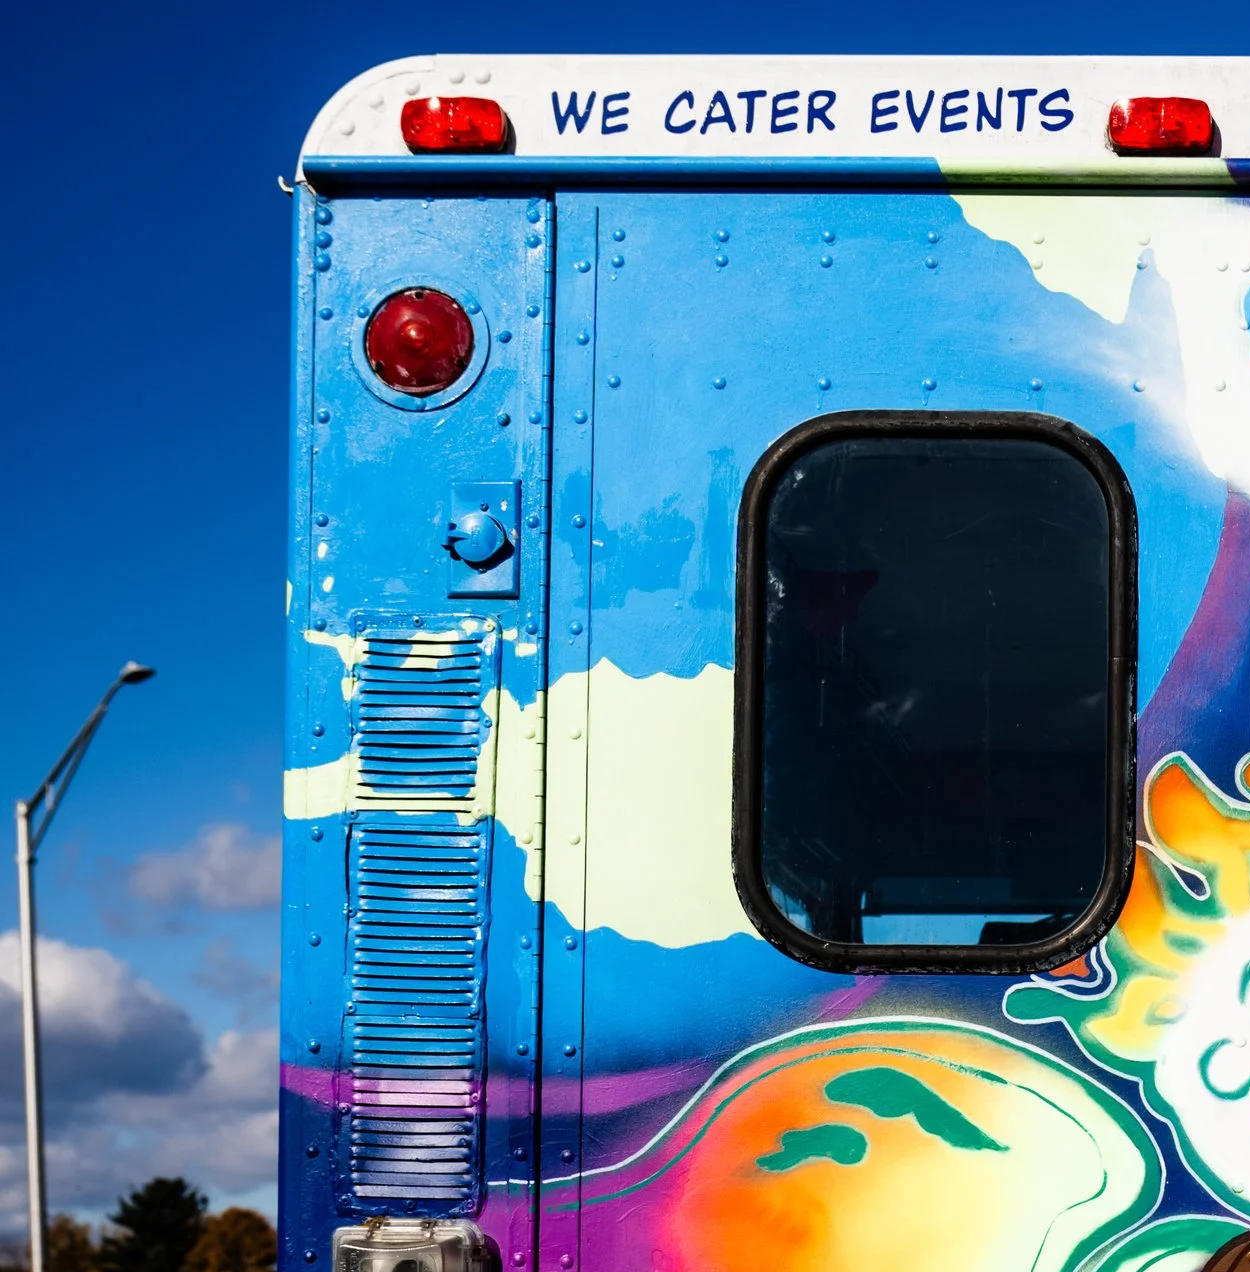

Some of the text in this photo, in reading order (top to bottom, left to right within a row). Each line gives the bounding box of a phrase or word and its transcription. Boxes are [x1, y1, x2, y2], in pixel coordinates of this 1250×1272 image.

[551, 87, 1075, 135] WE CATER EVENTS
